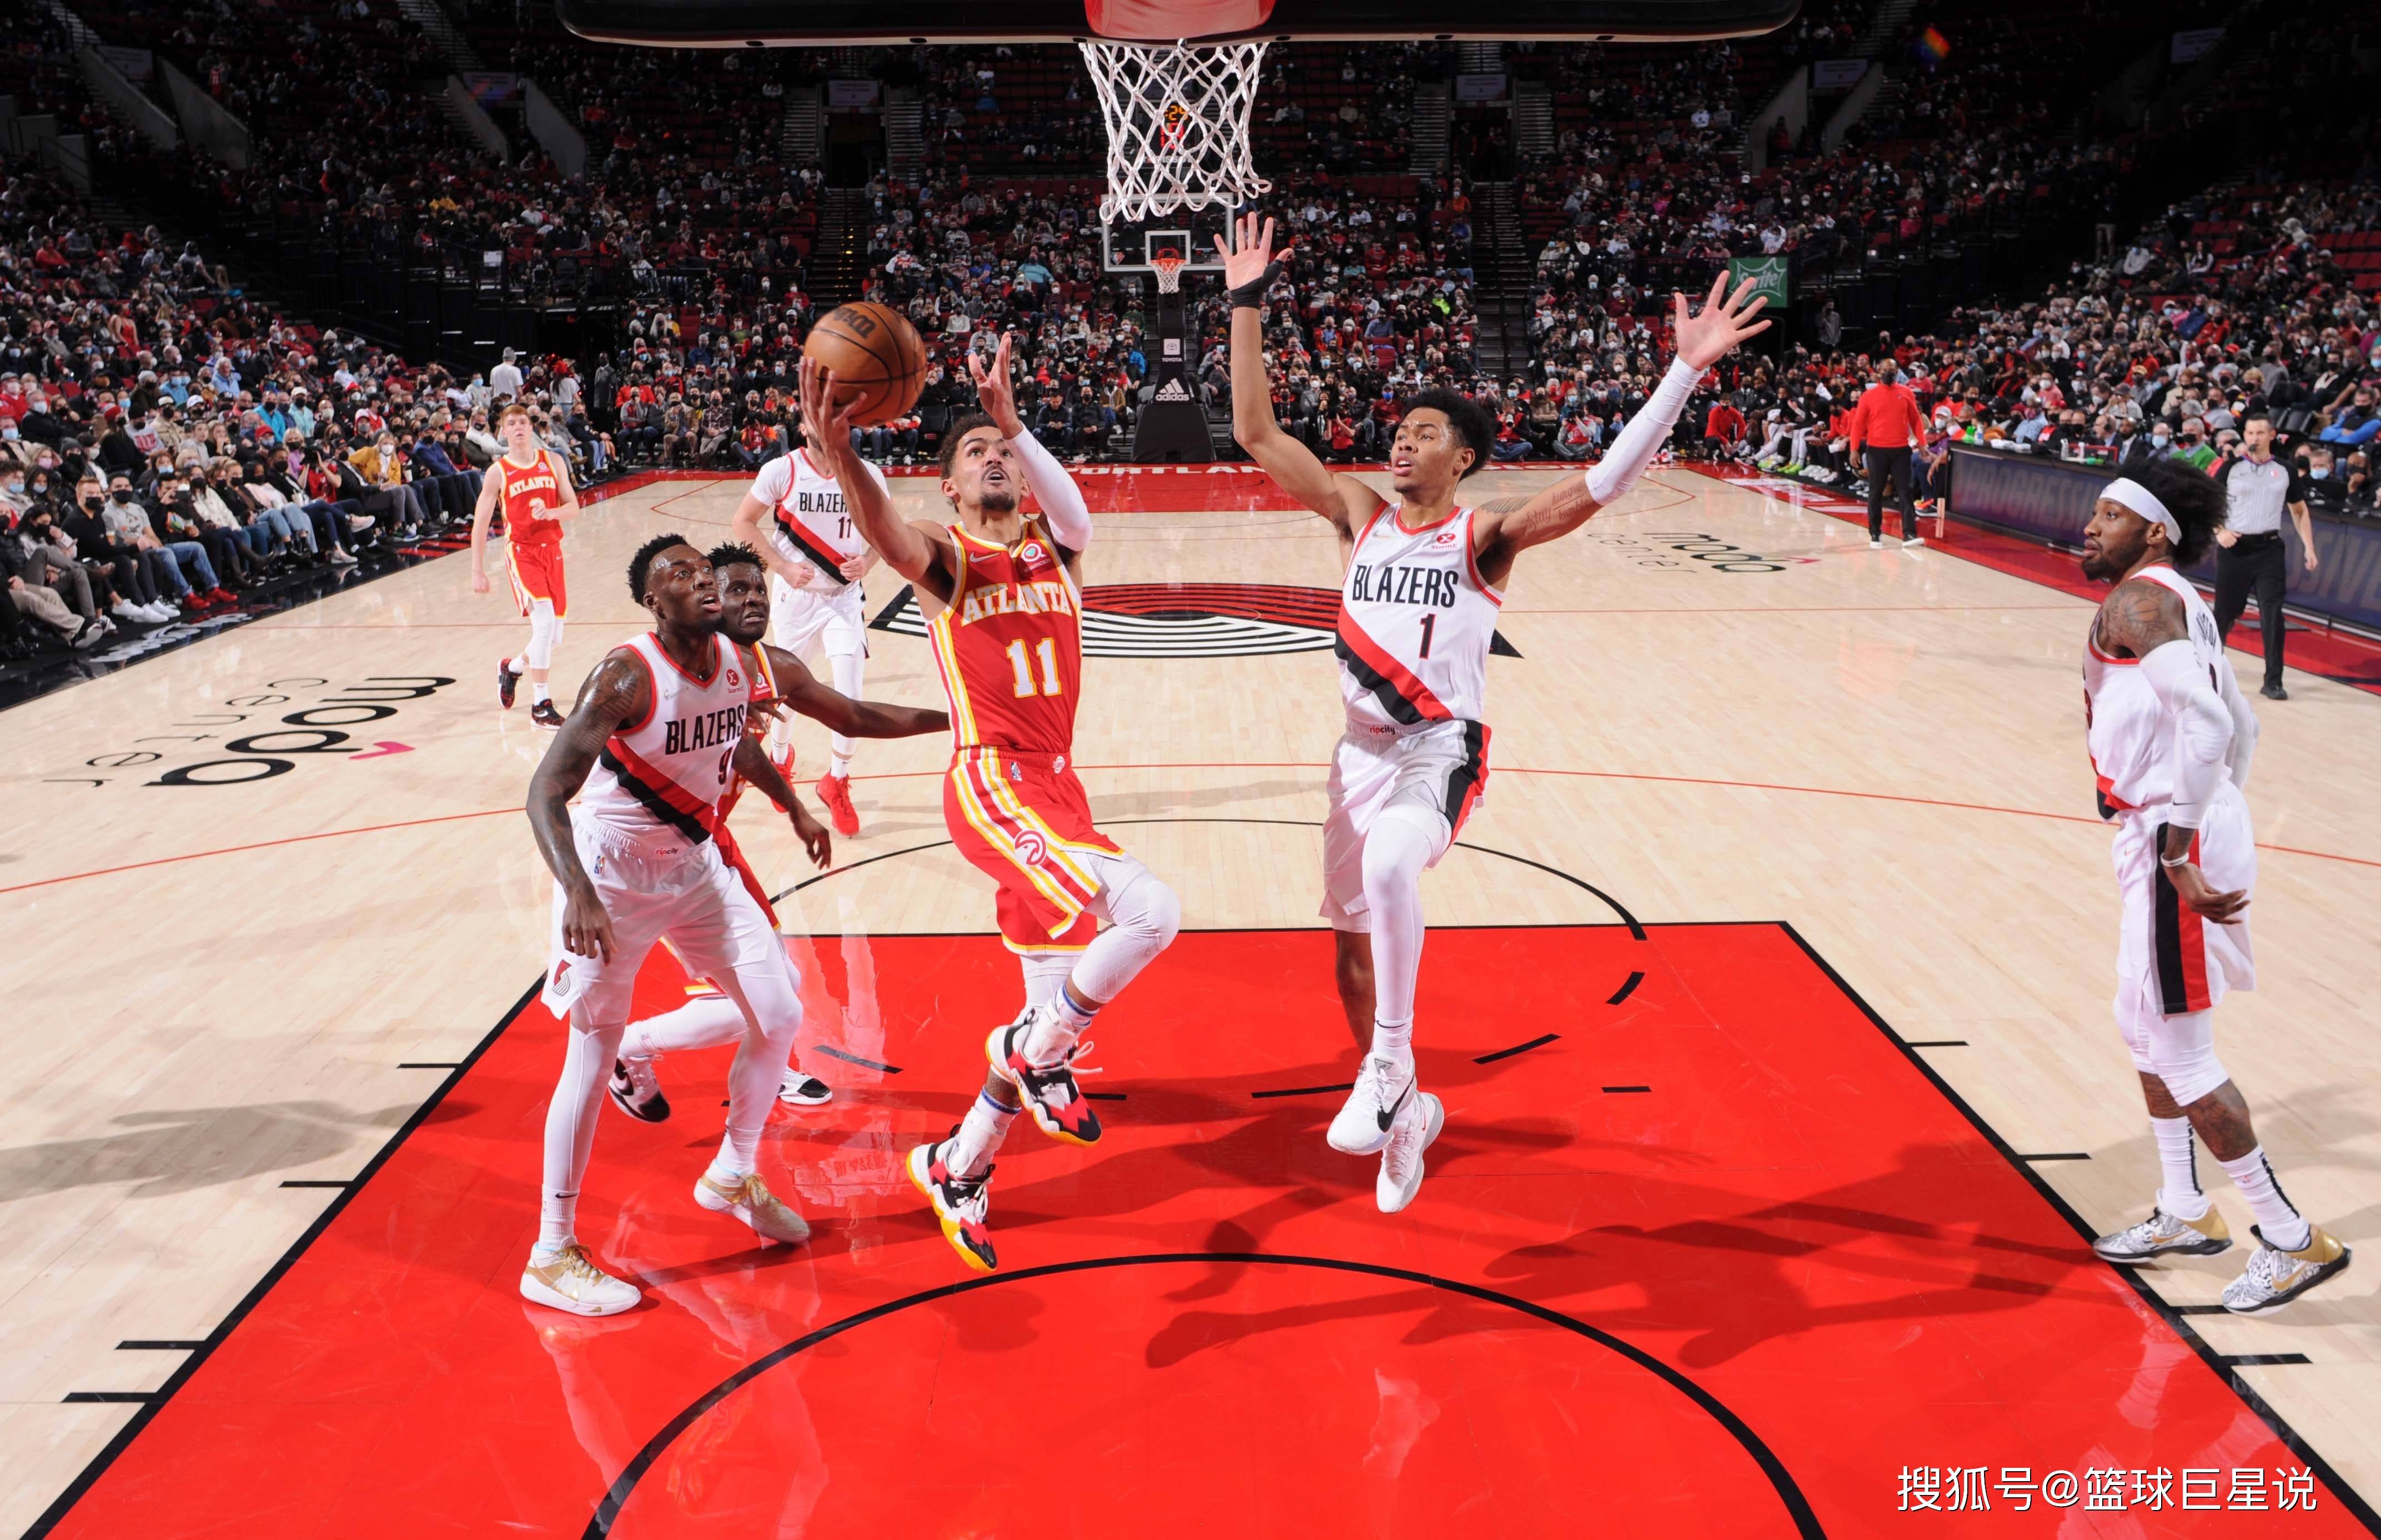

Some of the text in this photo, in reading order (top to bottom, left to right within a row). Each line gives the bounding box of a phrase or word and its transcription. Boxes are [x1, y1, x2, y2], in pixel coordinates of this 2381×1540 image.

[1739, 270, 1779, 290] Srite
[1155, 392, 1190, 401] adidas
[1063, 465, 1267, 475] PORTLAN
[509, 475, 556, 499] ATLANTA
[798, 492, 848, 513] BLAZER
[838, 516, 852, 539] 11
[1352, 564, 1459, 608] BLAZERS
[960, 581, 1073, 627] ATLANTA
[1419, 612, 1436, 660] 1
[1006, 637, 1062, 698] 11
[43, 677, 329, 787] center
[142, 676, 457, 787] moda
[665, 704, 745, 756] BLAZERS
[1369, 724, 1396, 736] ripcity
[718, 746, 734, 785] 9
[655, 848, 679, 856] ripcity
